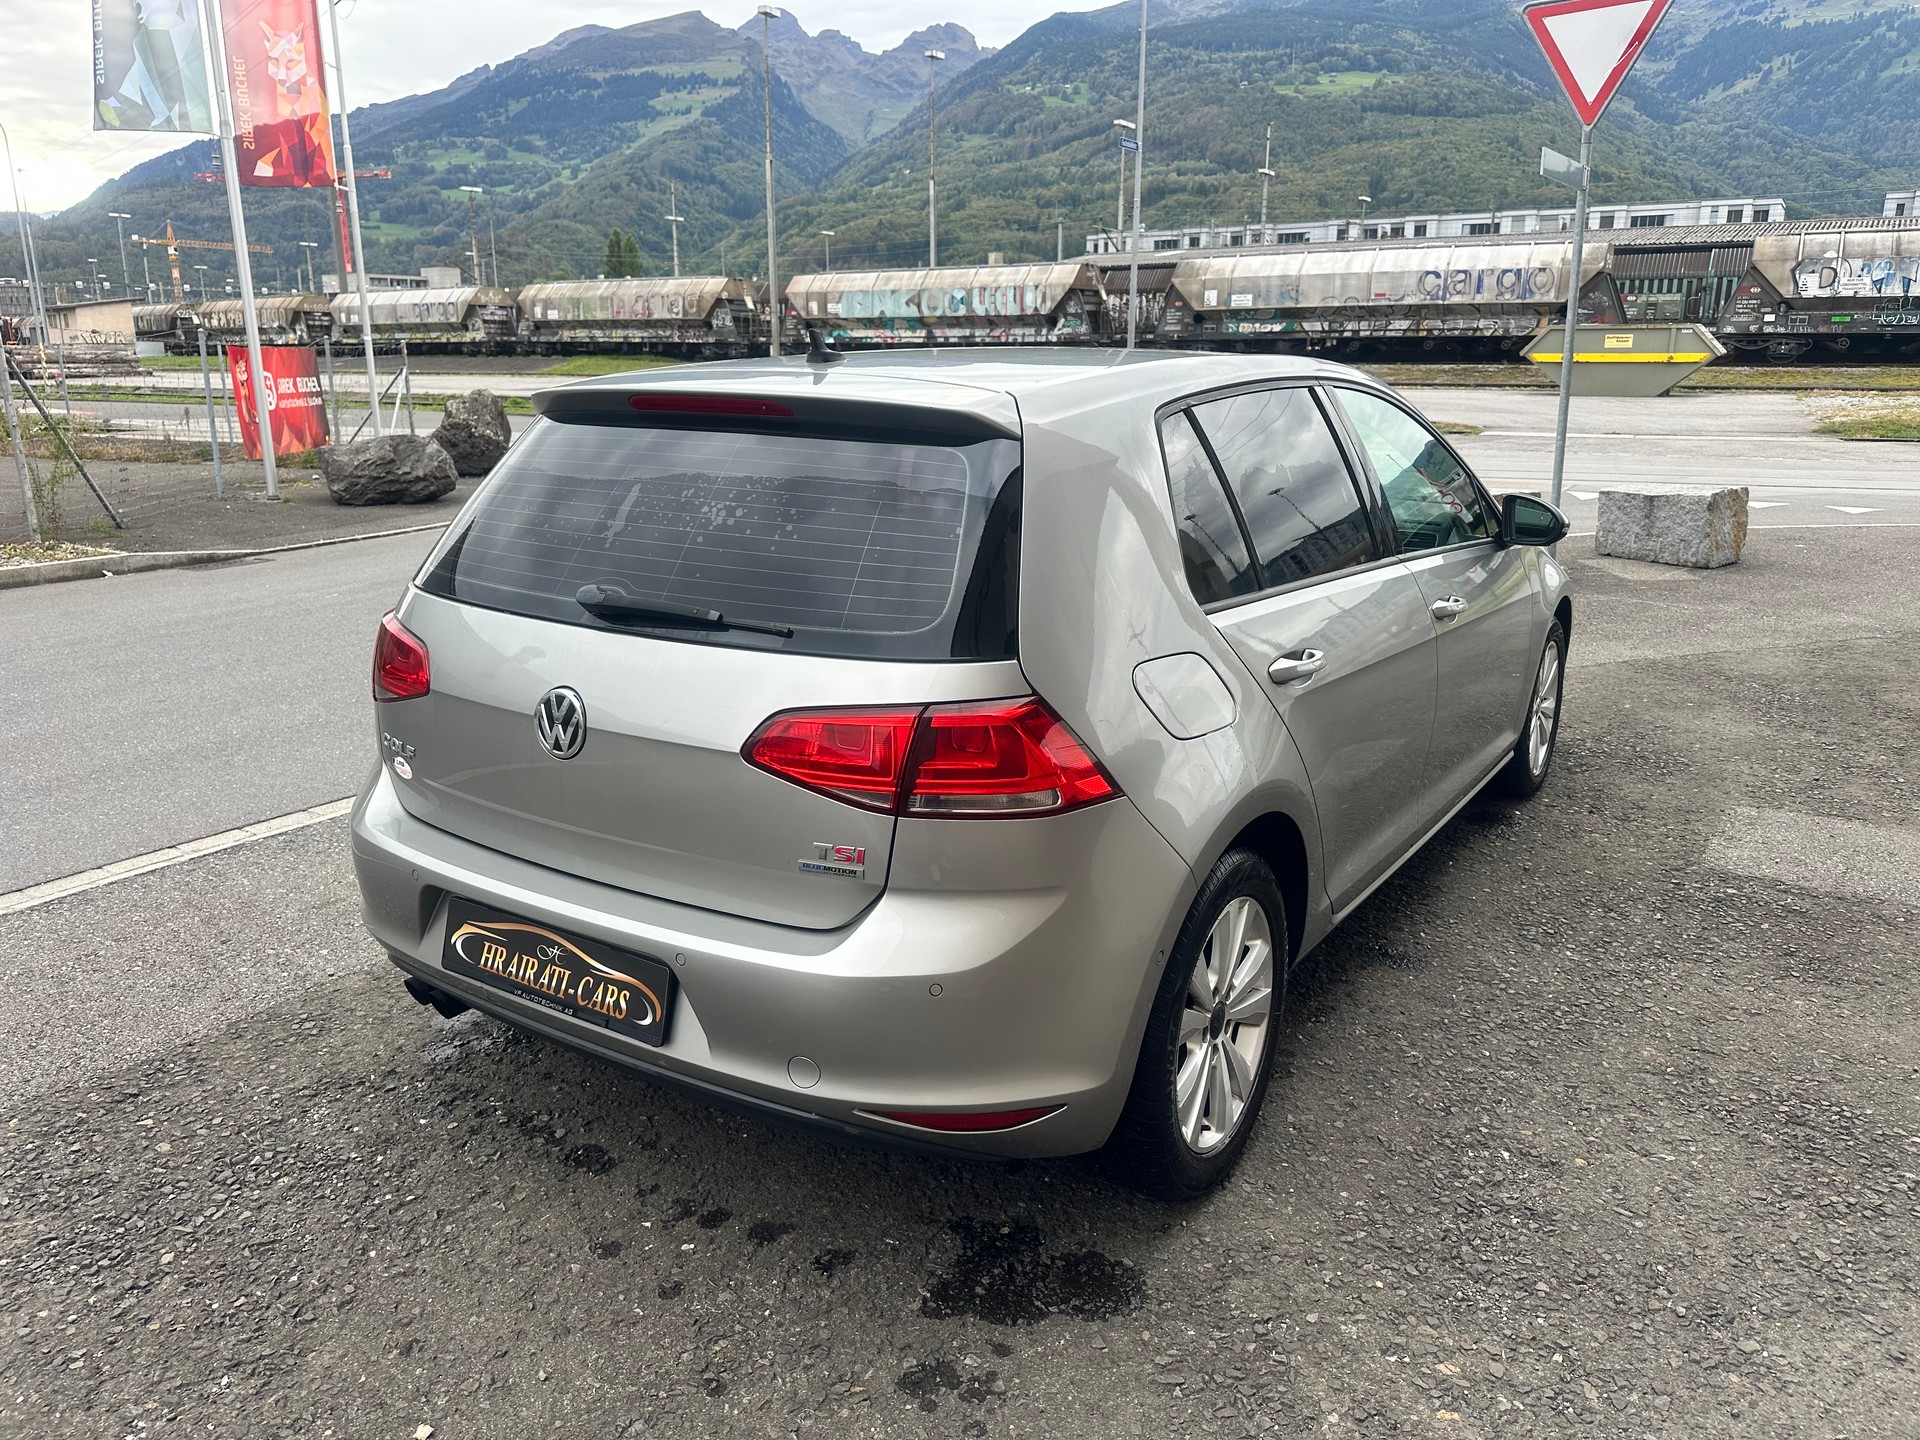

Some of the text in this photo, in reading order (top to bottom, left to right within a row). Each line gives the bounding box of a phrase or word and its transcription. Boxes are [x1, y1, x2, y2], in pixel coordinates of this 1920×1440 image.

[1417, 267, 1555, 300] cargo
[813, 841, 866, 865] TSI
[802, 862, 857, 875] BLUEMOTION
[477, 940, 631, 1020] HRAIRATI-CARS
